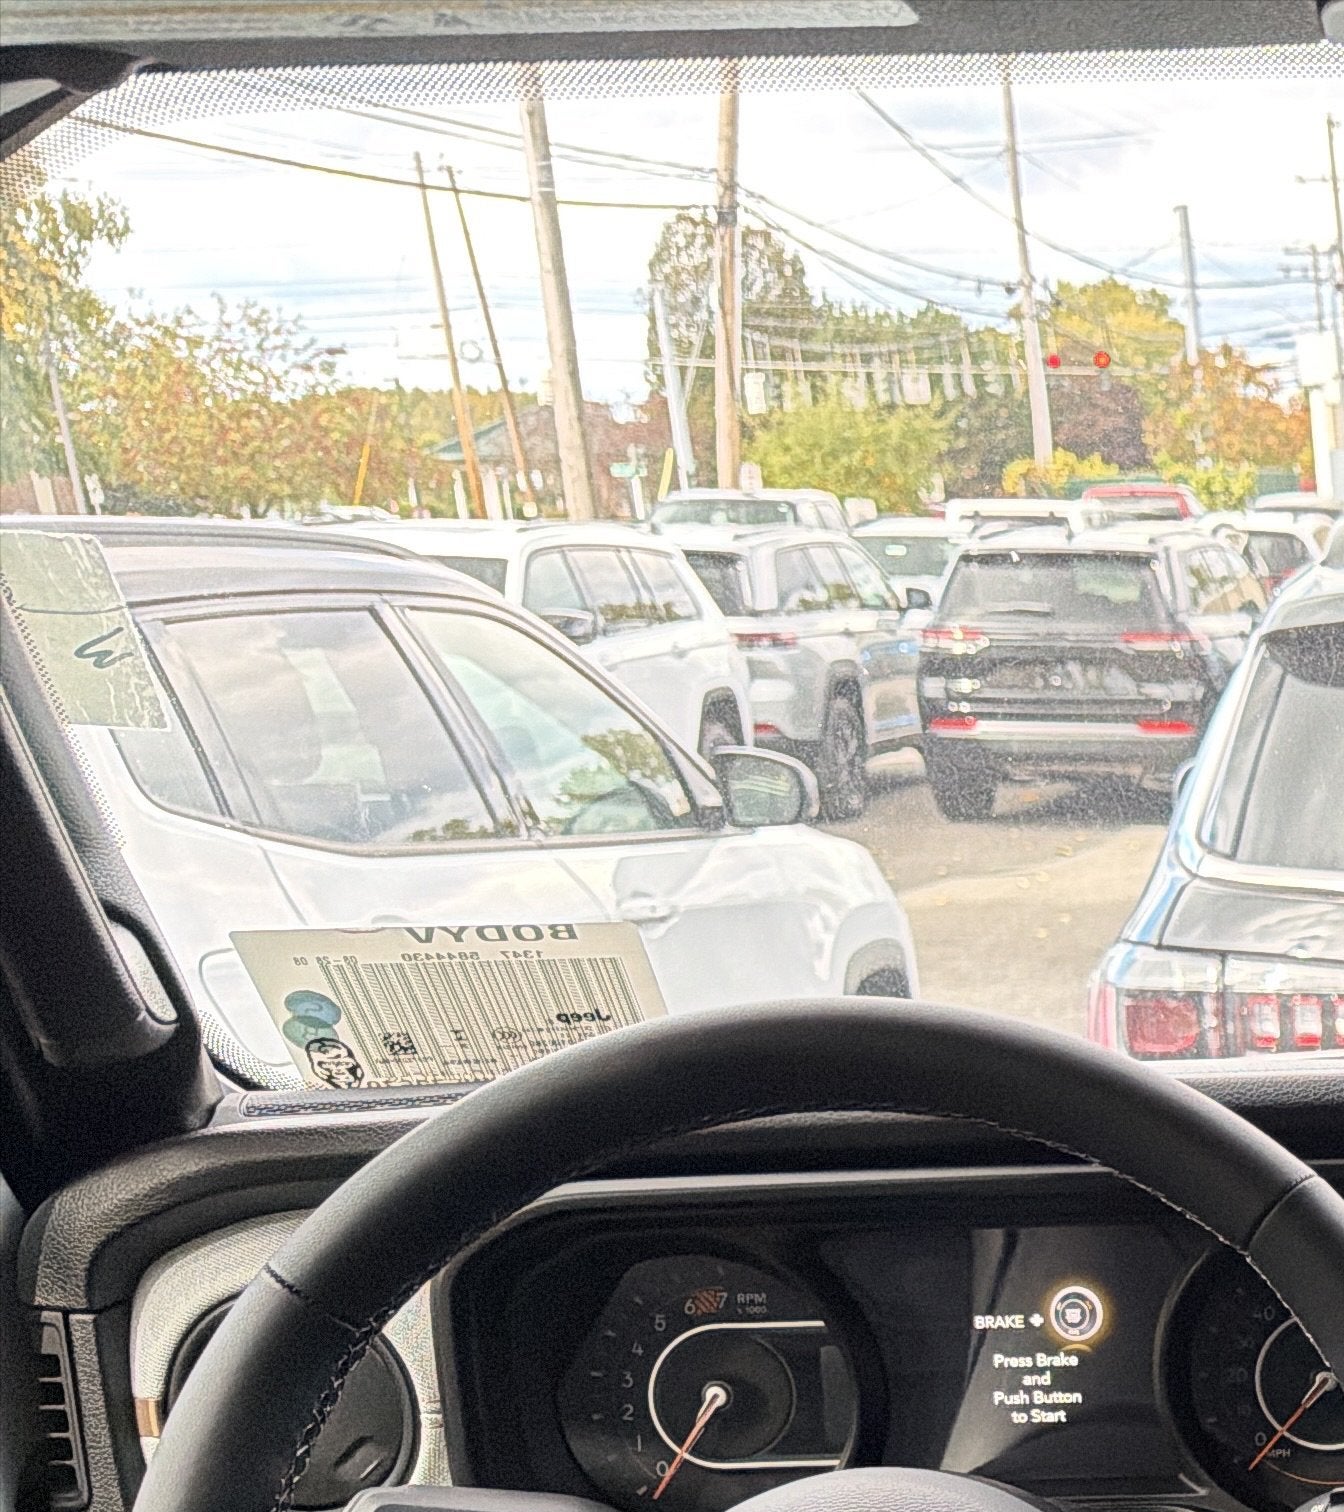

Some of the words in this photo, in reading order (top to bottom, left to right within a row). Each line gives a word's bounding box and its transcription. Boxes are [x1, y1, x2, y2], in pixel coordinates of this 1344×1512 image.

[719, 1292, 727, 1308] 7
[737, 1293, 767, 1304] RPM
[684, 1299, 695, 1314] 6
[655, 1315, 666, 1331] 5
[973, 1315, 1025, 1329] BRAKE
[632, 1341, 644, 1356] 4
[993, 1354, 1033, 1368] Press
[1036, 1352, 1078, 1367] Brake
[622, 1372, 633, 1388] 3
[1022, 1371, 1051, 1385] and
[993, 1390, 1030, 1405] Push
[1032, 1390, 1082, 1404] Button
[622, 1404, 634, 1420] 2
[1011, 1410, 1028, 1423] to
[1030, 1409, 1066, 1423] Start
